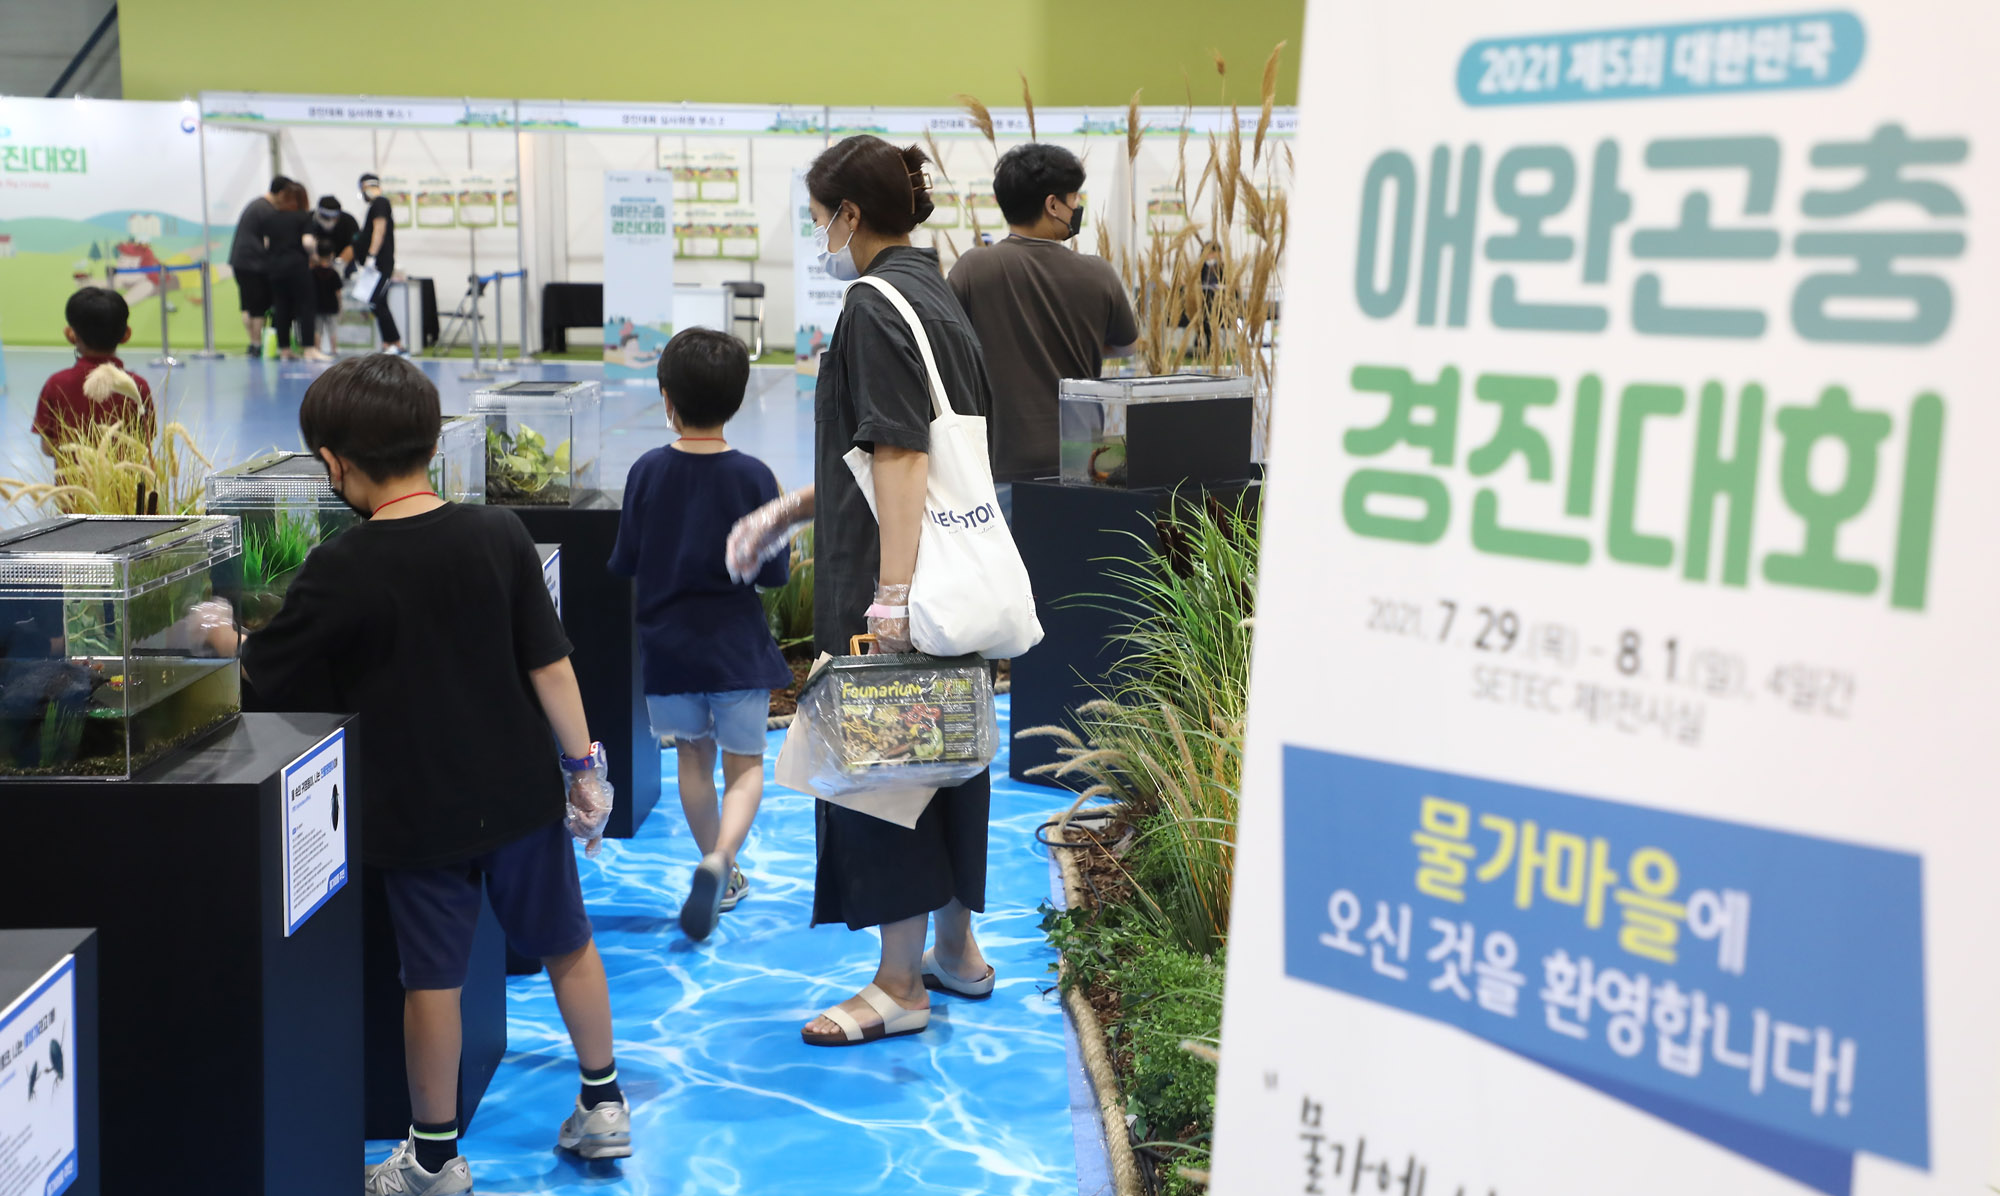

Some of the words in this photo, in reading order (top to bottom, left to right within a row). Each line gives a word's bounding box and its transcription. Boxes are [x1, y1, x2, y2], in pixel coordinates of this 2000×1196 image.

[1477, 43, 1561, 94] 2021
[1566, 33, 1667, 92] 제5회
[1673, 20, 1835, 86] 대한민국
[1354, 122, 1970, 346] 애완곤충
[1342, 365, 1945, 612] 경진대회
[842, 681, 922, 699] Faunarium
[1471, 664, 1564, 714] SETEC
[1571, 679, 1707, 749] 제1전시실
[1765, 663, 1857, 720] 4일간
[1413, 796, 1750, 976] 물가마을에
[1319, 889, 1412, 981] 오신
[1428, 917, 1526, 1018] 것을
[1540, 948, 1857, 1117] 환영합니다!
[1300, 1095, 1427, 1196] 물가에
